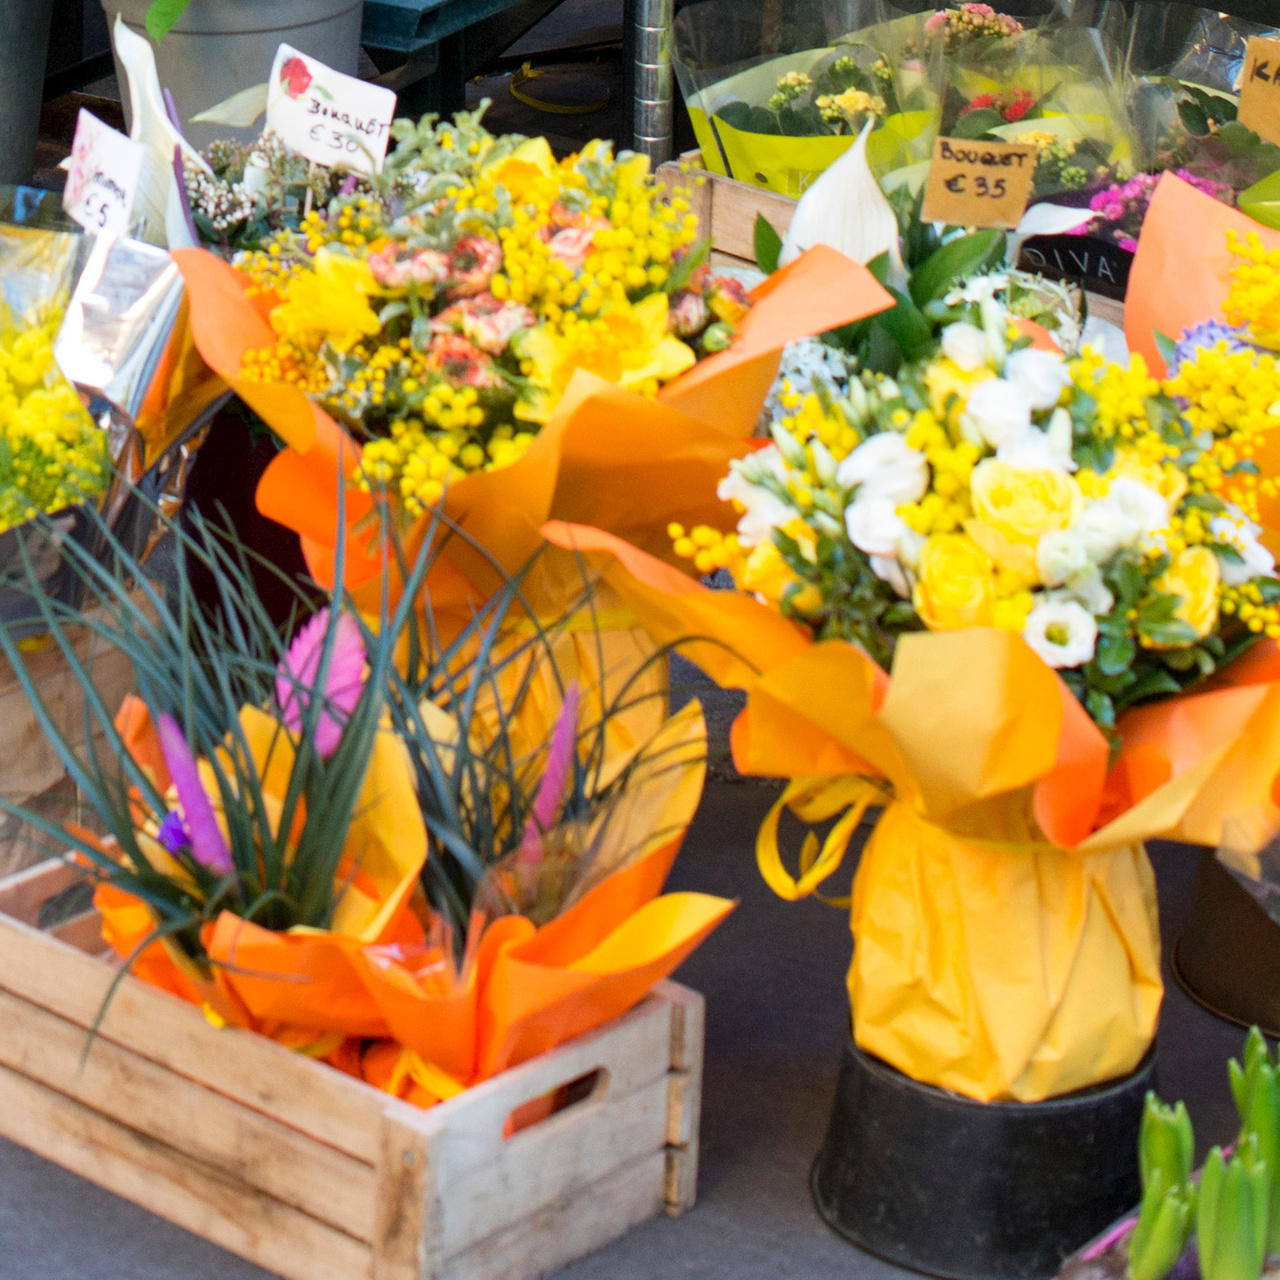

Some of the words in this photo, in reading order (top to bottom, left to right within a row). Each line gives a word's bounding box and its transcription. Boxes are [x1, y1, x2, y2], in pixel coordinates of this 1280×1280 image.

[308, 98, 392, 137] BOUQUET
[940, 141, 1029, 168] BOUQUET
[1023, 246, 1116, 284] DIVA
